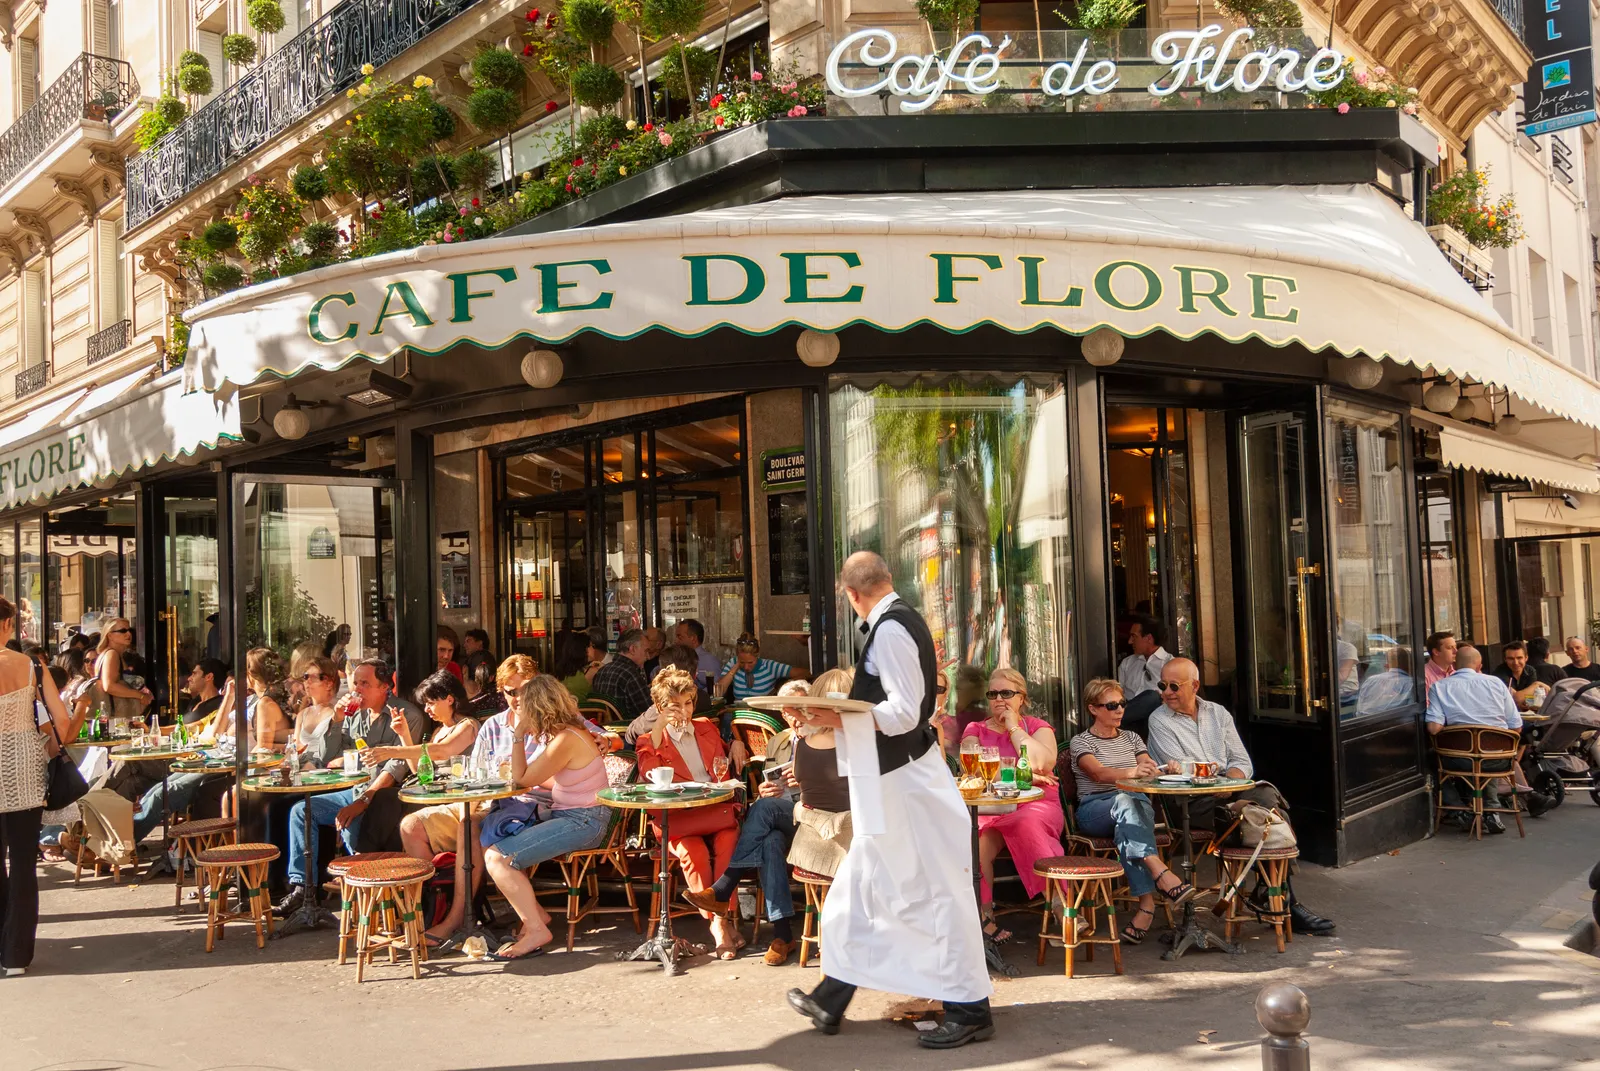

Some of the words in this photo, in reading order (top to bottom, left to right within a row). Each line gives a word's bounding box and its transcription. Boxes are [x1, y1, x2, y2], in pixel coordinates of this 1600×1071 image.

[826, 28, 1011, 113] Café
[1041, 38, 1119, 96] de
[1148, 23, 1346, 98] Flore
[1532, 106, 1549, 121] de
[1555, 101, 1587, 116] Paris
[1546, 115, 1585, 129] GERMAIN
[306, 258, 616, 346] CAFE
[680, 249, 868, 307] DE
[928, 251, 1299, 324] FLORE
[0, 432, 86, 494] FLORE
[770, 455, 805, 469] BOULEVAR
[766, 469, 785, 481] SAINT
[786, 467, 805, 479] GERM
